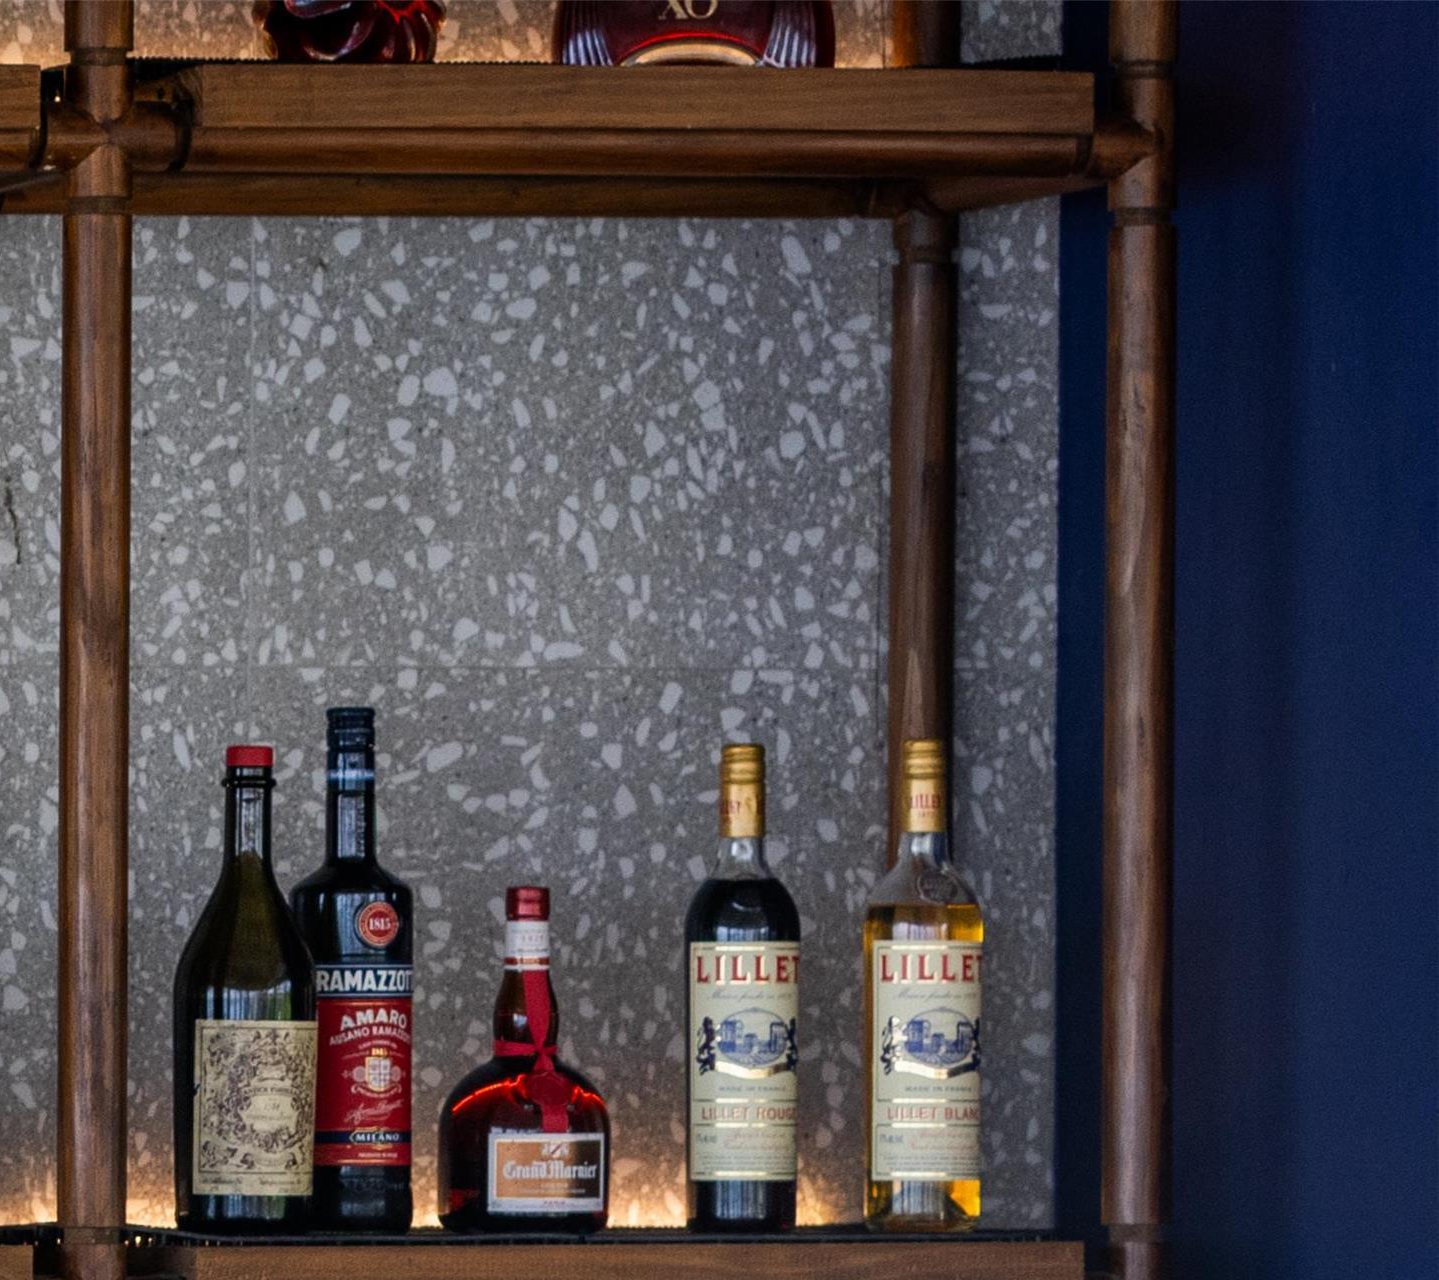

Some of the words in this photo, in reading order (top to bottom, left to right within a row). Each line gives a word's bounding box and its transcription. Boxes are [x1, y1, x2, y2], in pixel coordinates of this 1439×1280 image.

[369, 916, 391, 931] 1815
[340, 1006, 408, 1031] AMARO
[887, 1105, 939, 1120] LILLET
